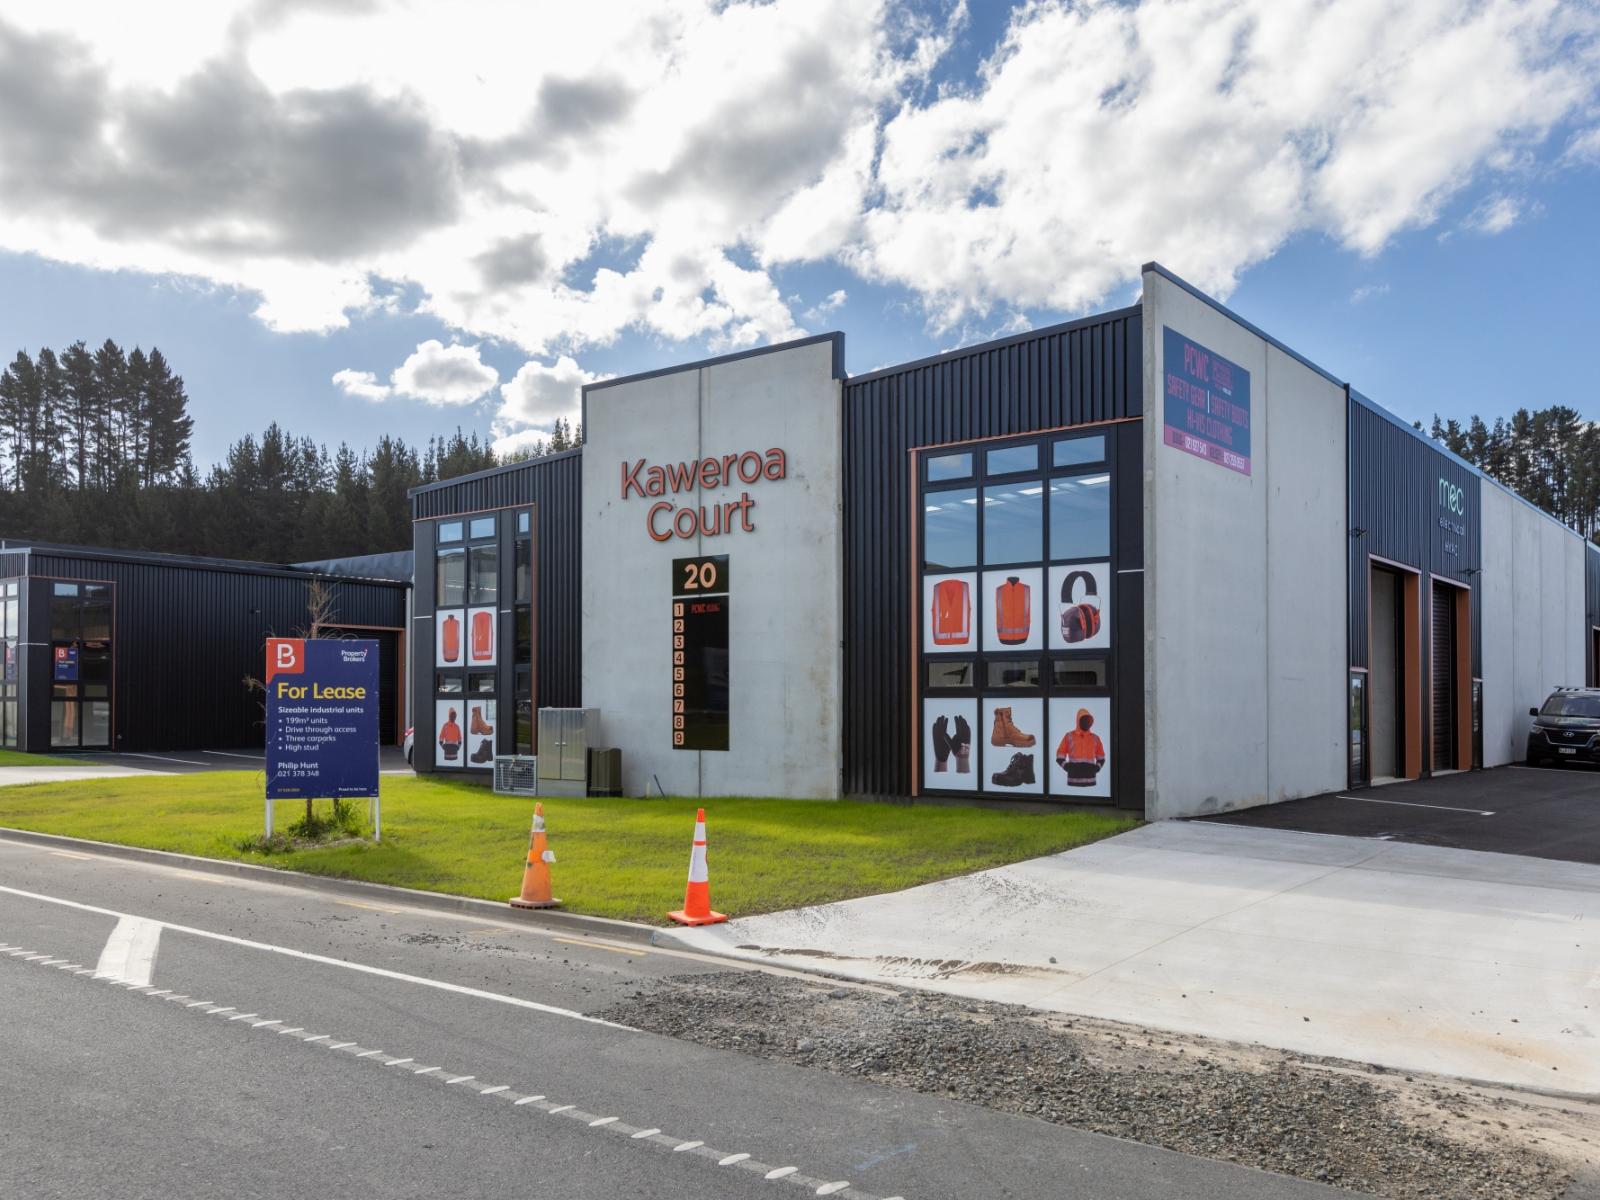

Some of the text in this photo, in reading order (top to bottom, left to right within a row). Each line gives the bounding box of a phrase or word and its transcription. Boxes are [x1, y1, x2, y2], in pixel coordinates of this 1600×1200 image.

[1184, 343, 1209, 382] PCWC
[1168, 373, 1189, 401] SAFETY
[1190, 385, 1206, 408] GEAR
[1211, 394, 1232, 420] SAFETY
[621, 448, 786, 499] Kaweroa
[1438, 476, 1464, 516] mec
[646, 492, 755, 542] Court
[684, 562, 716, 590] 20
[676, 604, 681, 615] 1
[676, 620, 682, 631] 2
[676, 636, 682, 646] 3
[278, 644, 295, 667] B
[341, 650, 367, 658] Property
[676, 652, 682, 663] 4
[676, 668, 682, 679] 5
[278, 683, 365, 699] For Lease
[676, 684, 682, 695] 6
[676, 700, 682, 711] 7
[676, 717, 682, 727] 8
[305, 726, 333, 734] through
[676, 733, 682, 743] 9
[278, 762, 299, 770] Philip
